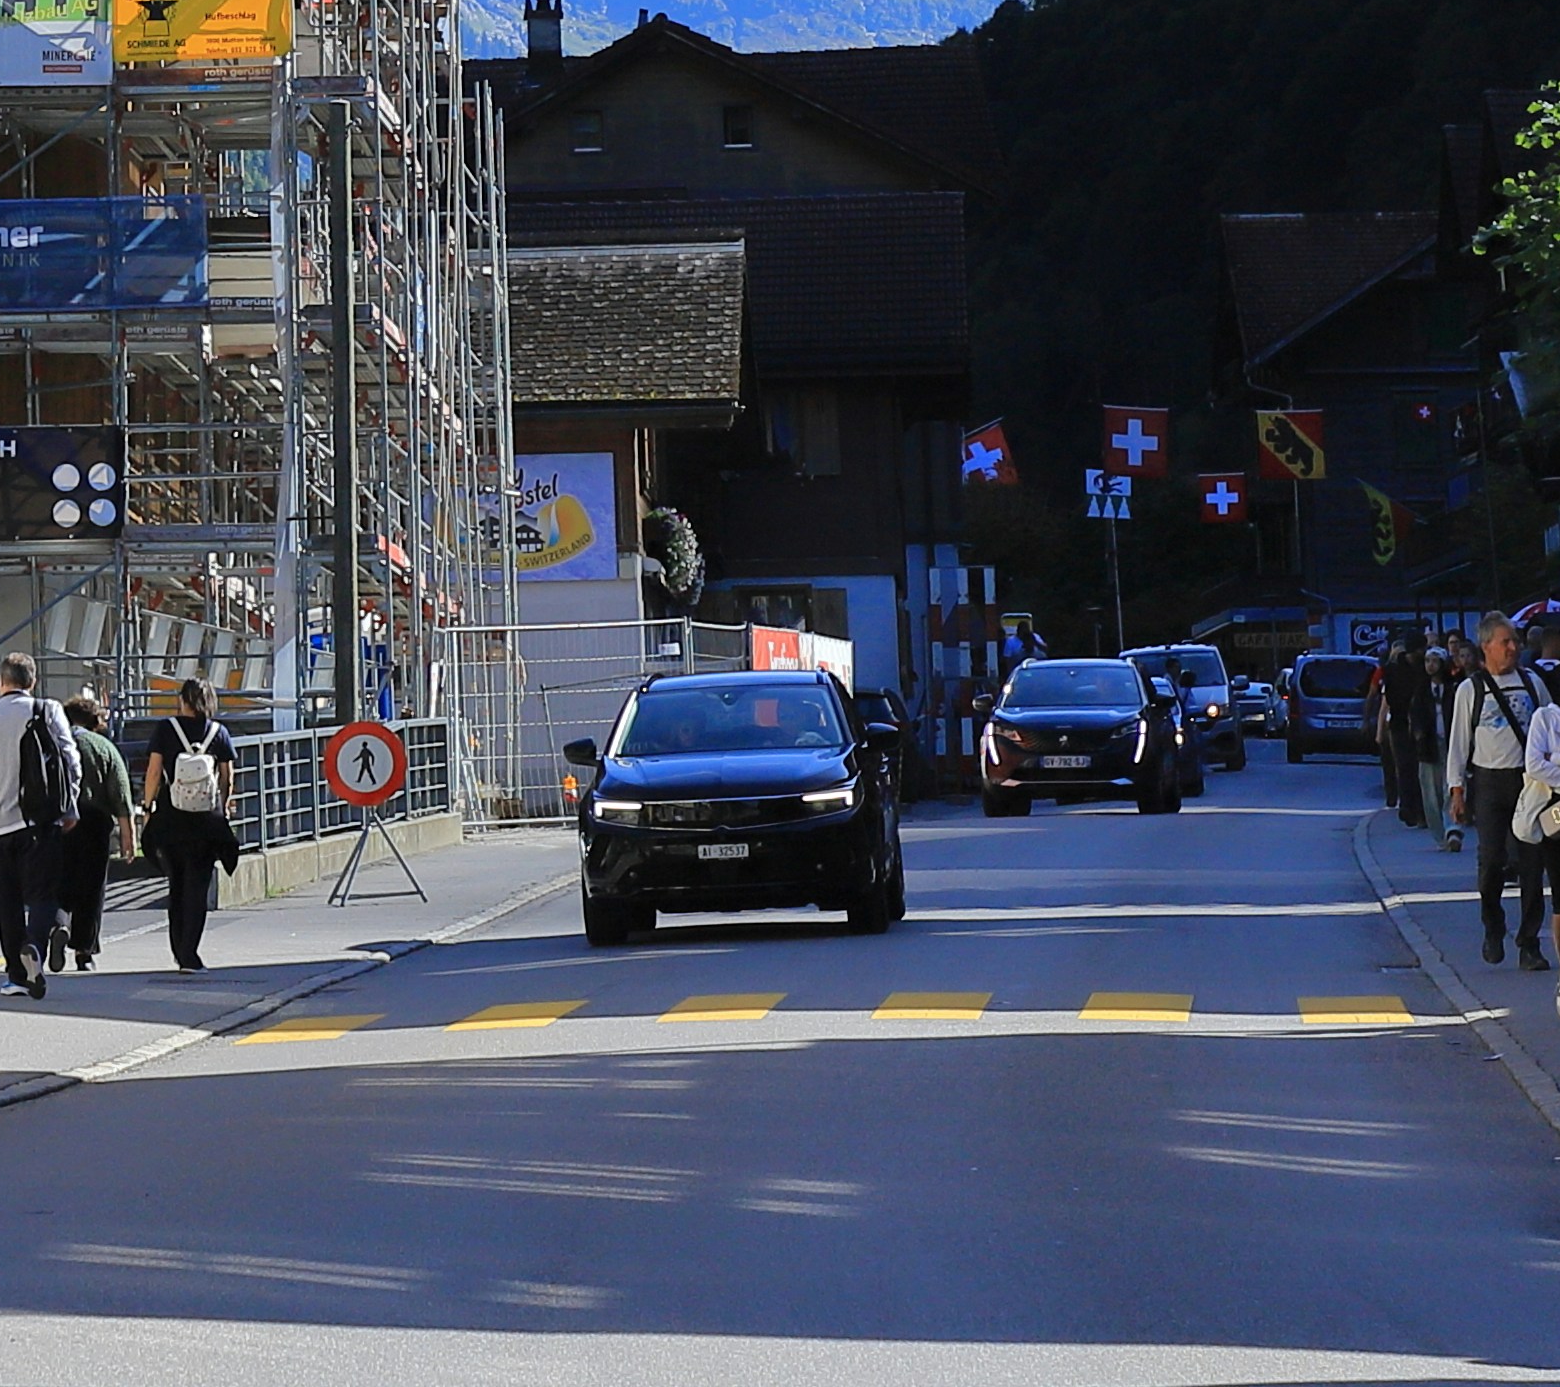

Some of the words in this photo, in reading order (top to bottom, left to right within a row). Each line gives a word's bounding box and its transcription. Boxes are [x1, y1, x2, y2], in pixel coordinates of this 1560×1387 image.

[127, 39, 170, 49] SCHMIEDE
[174, 38, 186, 47] AG
[205, 68, 227, 77] roth
[210, 297, 233, 306] roth
[523, 533, 592, 568] SWITZERLAND
